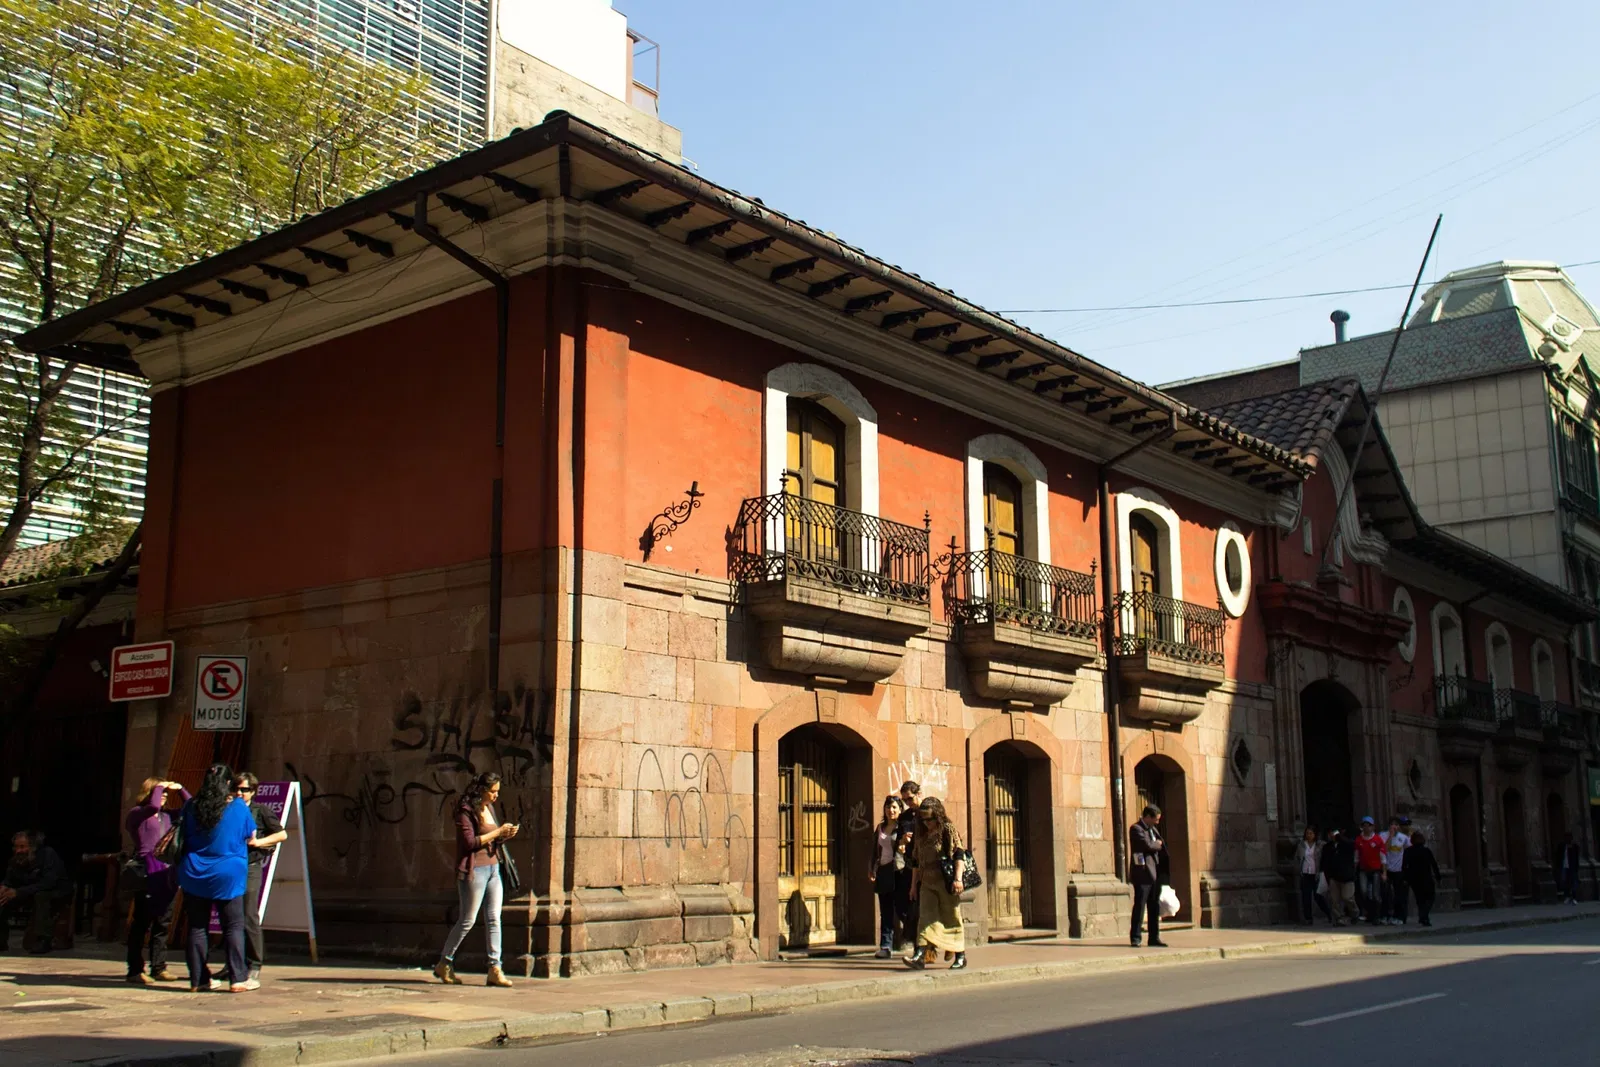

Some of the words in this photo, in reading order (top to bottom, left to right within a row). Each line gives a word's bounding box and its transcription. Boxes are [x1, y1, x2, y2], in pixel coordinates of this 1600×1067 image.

[130, 653, 155, 662] Acceso
[197, 707, 240, 721] MOTOS
[257, 784, 280, 796] ERTA
